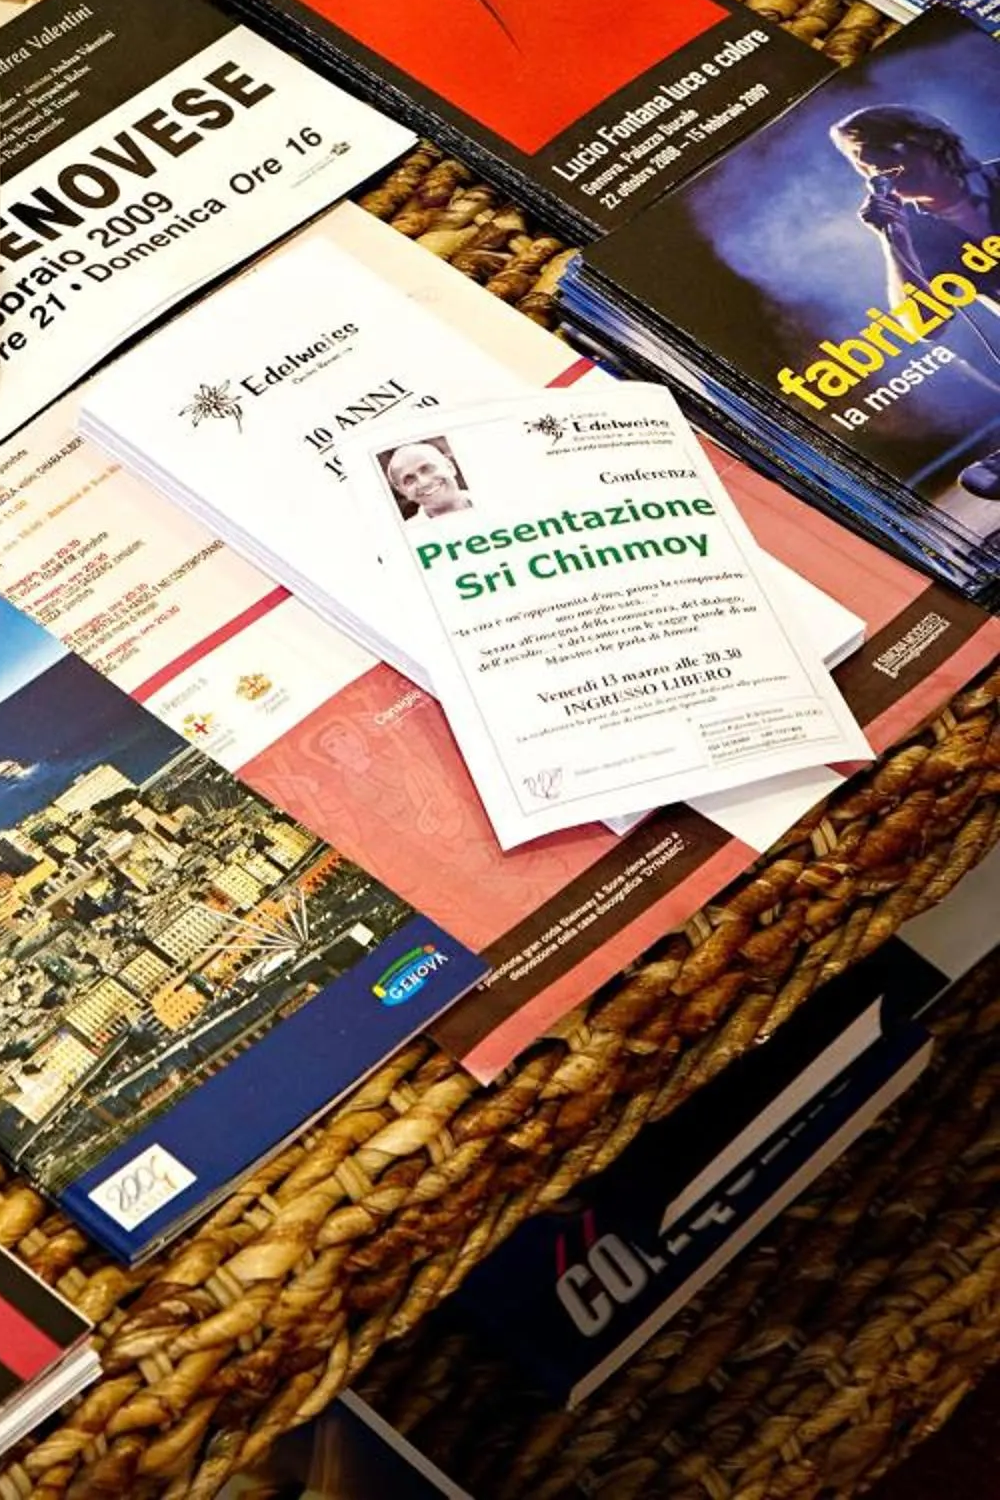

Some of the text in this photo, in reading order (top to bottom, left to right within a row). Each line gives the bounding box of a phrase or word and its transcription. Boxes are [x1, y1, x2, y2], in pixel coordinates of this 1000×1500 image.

[23, 0, 95, 54] Valentini
[548, 20, 771, 183] Lucio Fontana luce e colore
[619, 128, 668, 166] Palazzo
[657, 104, 701, 138] Ducale
[598, 189, 623, 212] 22
[614, 161, 659, 199] ottobre
[684, 125, 706, 146] 15
[697, 97, 747, 138] febbraio
[737, 80, 771, 109] 2009
[25, 290, 70, 331] 21
[82, 183, 228, 296] Domenica
[225, 148, 286, 201] Ore
[282, 121, 326, 163] 16
[84, 182, 177, 258] 2009
[239, 311, 360, 401] Edelweiss
[776, 272, 979, 411] fabrizio
[302, 422, 336, 454] 10
[332, 374, 408, 433] ANNI
[830, 336, 958, 434] la mostra
[598, 465, 698, 486] Conferenza
[415, 496, 717, 570] Presentazione
[455, 531, 711, 602] Sri Chinmoy
[562, 663, 732, 717] INGRESSO LIBERO
[600, 672, 620, 689] 13
[621, 662, 671, 684] marzo
[672, 653, 701, 672] alle
[389, 949, 449, 1001] GENOVA
